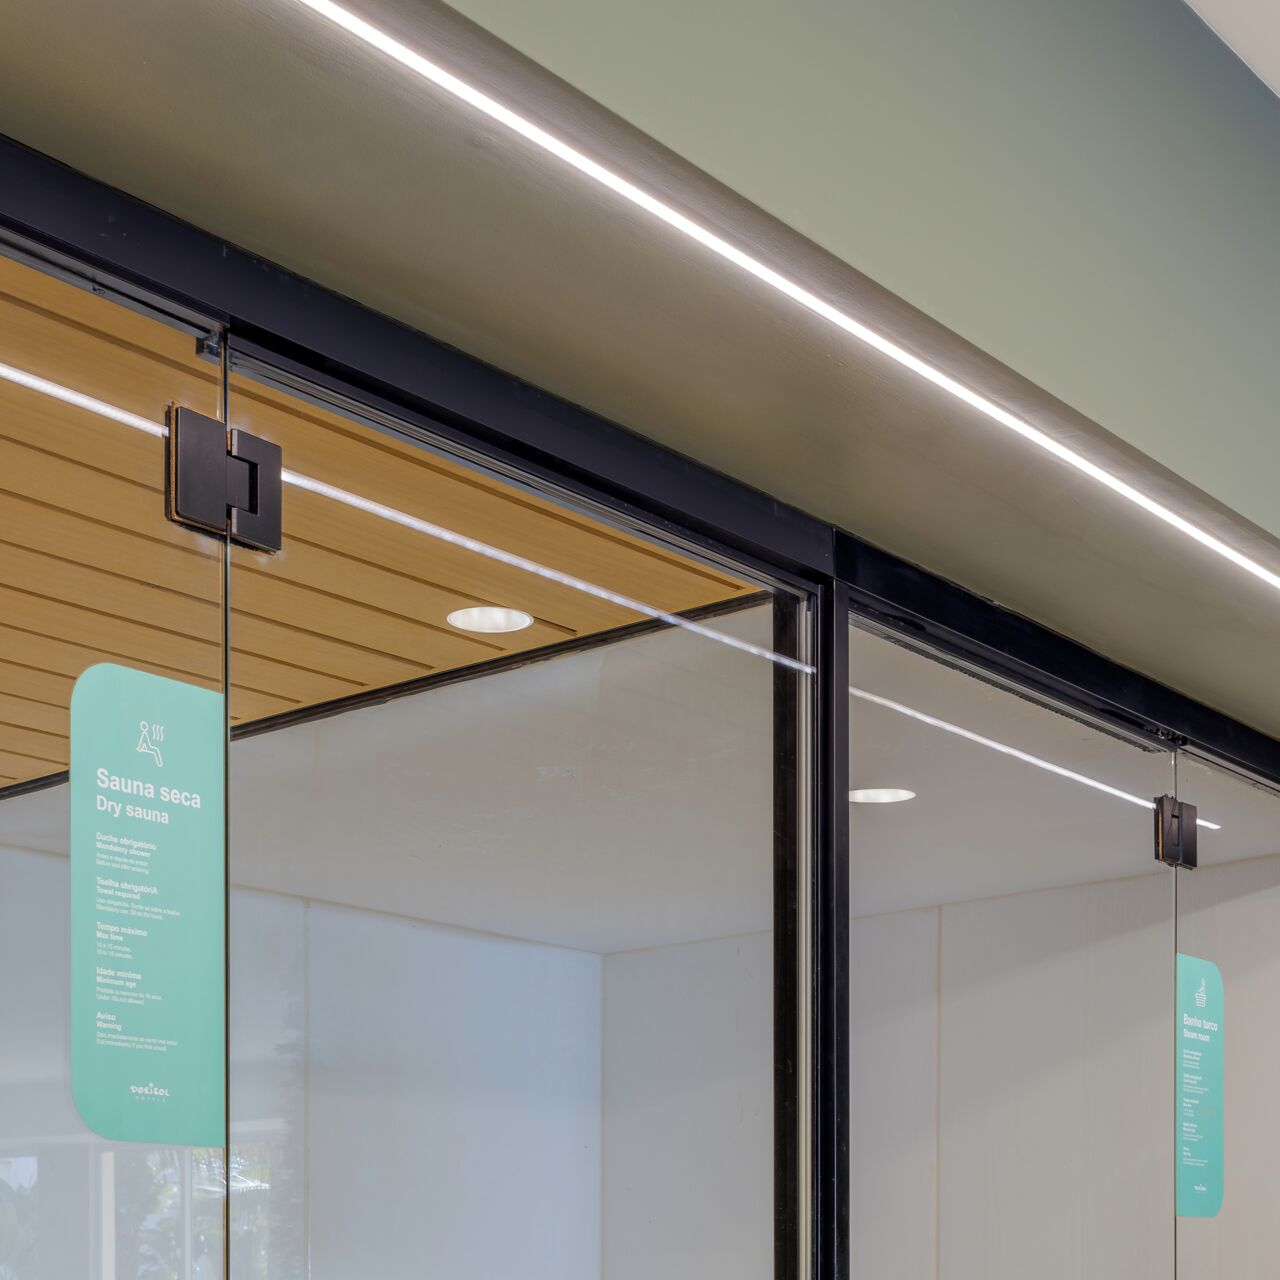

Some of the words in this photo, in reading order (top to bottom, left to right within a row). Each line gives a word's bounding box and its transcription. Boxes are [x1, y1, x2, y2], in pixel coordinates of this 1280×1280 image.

[96, 768, 155, 799] Sauna
[160, 786, 201, 808] seca
[96, 794, 122, 818] Dry
[126, 804, 169, 825] sauna
[1184, 1013, 1202, 1028] Banho
